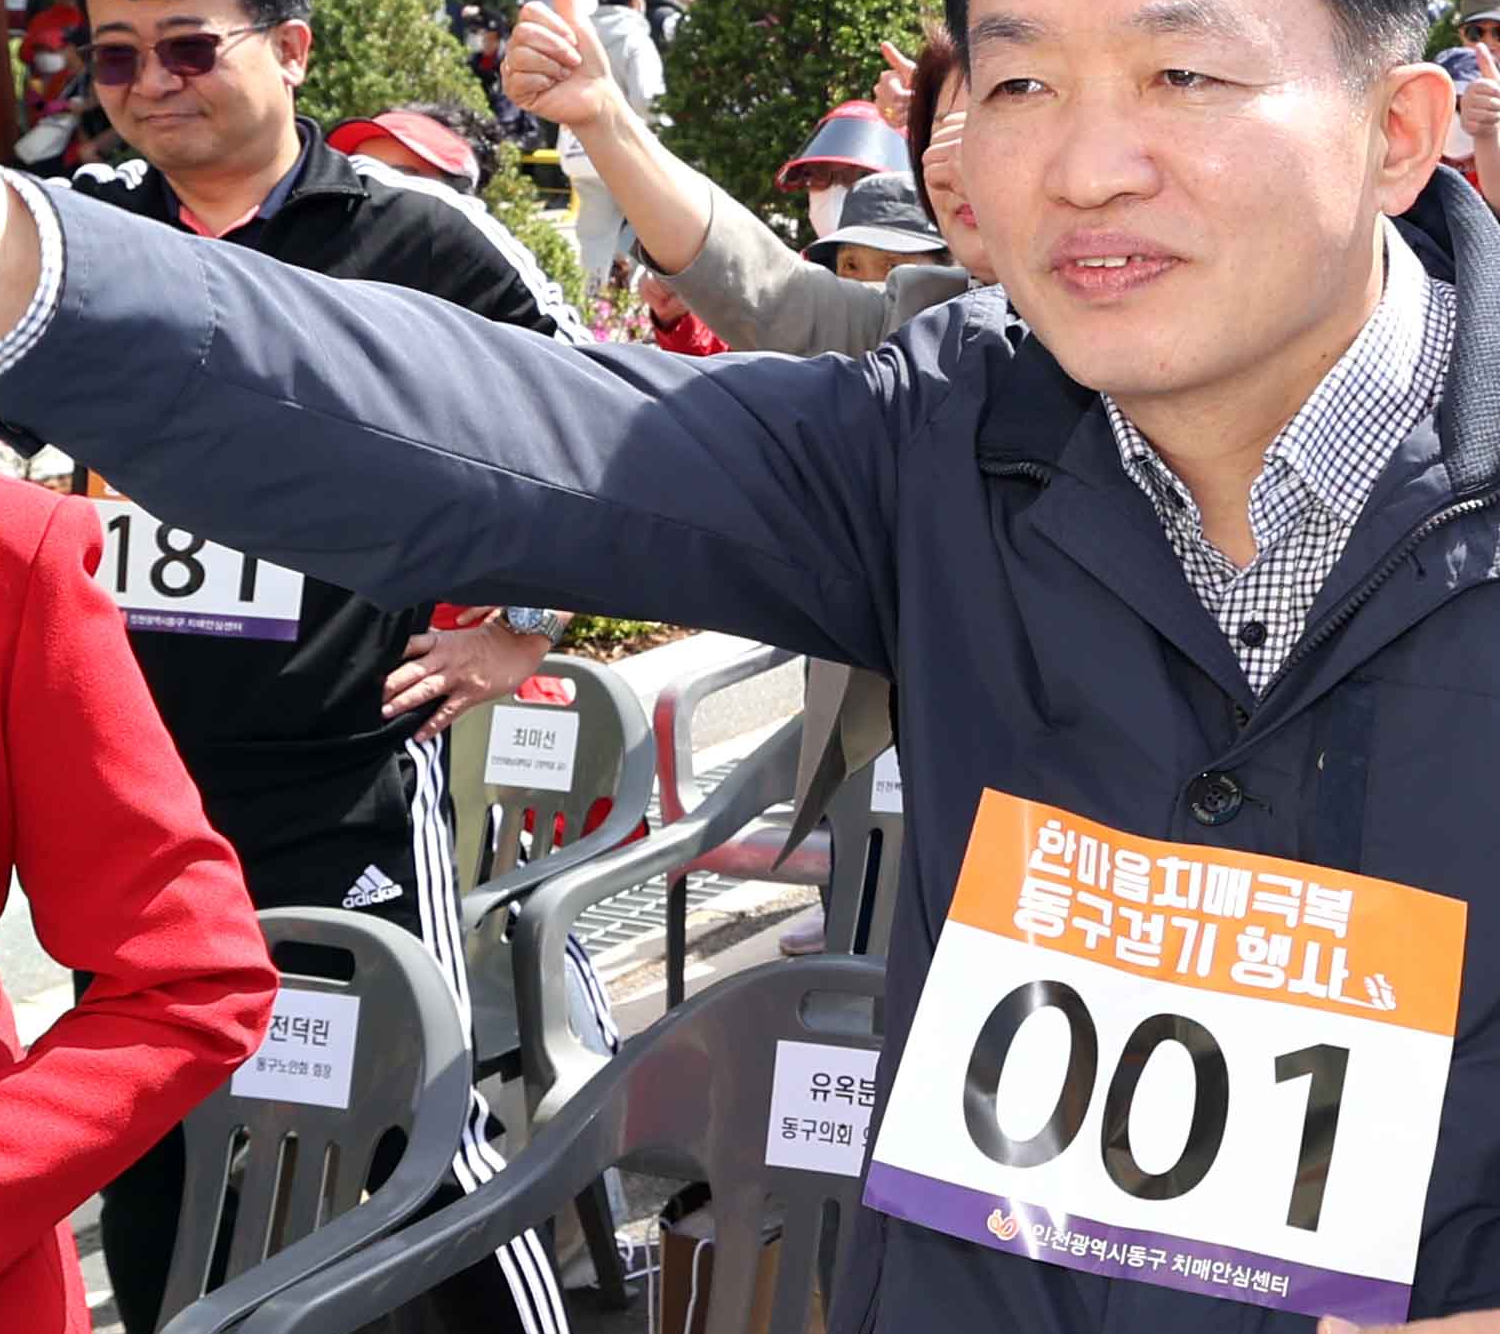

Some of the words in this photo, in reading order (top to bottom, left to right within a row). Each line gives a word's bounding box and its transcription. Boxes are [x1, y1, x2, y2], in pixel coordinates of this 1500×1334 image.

[108, 515, 258, 602] 181
[342, 884, 403, 908] adidas
[1028, 819, 1353, 937] 한마음치매극복
[1014, 876, 1217, 978] 동구걷기
[1228, 925, 1351, 1003] 행사
[270, 1015, 330, 1047] 전덕린
[781, 1117, 853, 1147] 동구의회
[963, 979, 1350, 1233] 001
[1030, 1222, 1167, 1271] 인천광역시동구
[1171, 1252, 1289, 1298] 치매안심센터
